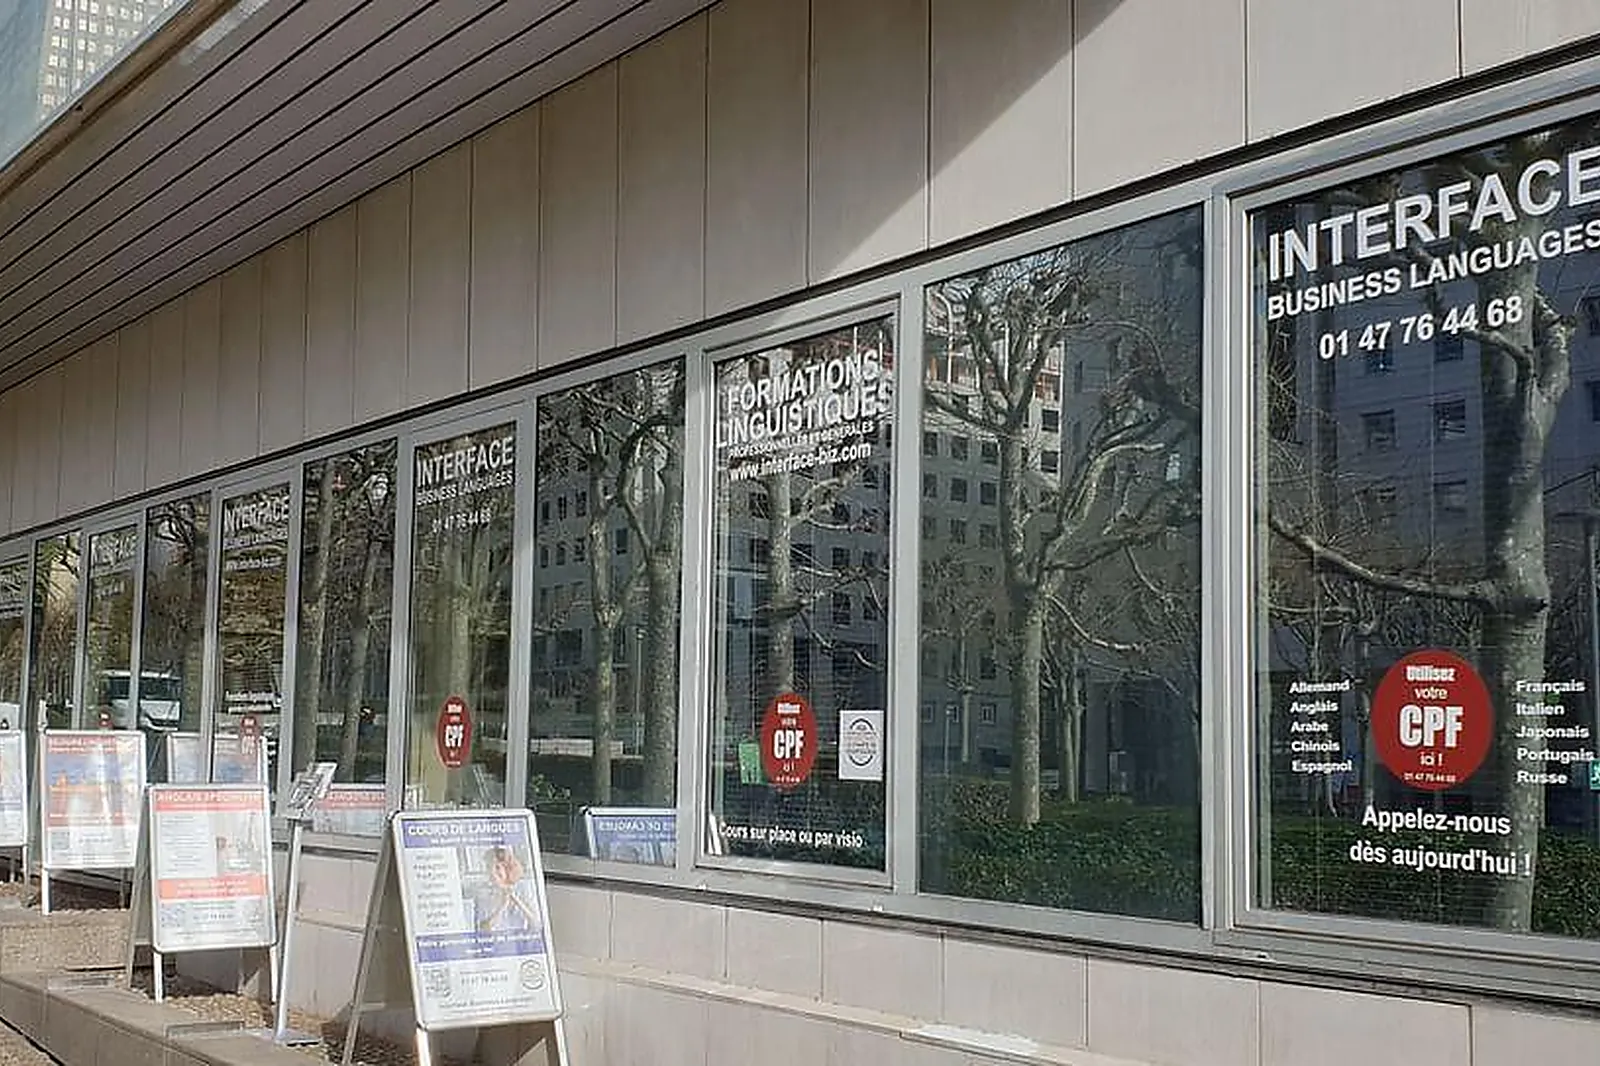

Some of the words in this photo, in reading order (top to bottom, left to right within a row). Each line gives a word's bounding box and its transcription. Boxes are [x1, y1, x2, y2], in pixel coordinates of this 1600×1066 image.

[1269, 144, 1600, 282] INTERFACE
[1267, 266, 1401, 320] BUSINESS
[1409, 218, 1600, 289] LANGUAGES
[1319, 329, 1348, 359] 01
[1358, 320, 1391, 351] 47
[1400, 312, 1435, 344] 76
[1442, 303, 1479, 335] 44
[1486, 295, 1523, 328] 68
[728, 349, 879, 414] FORMATIONS
[716, 381, 892, 449] LINGUISTIQUES
[416, 436, 514, 488] INTERFACE
[729, 443, 872, 481] www.interface-biz.com
[1289, 679, 1351, 695] Allemand
[1414, 686, 1449, 700] votre
[1516, 679, 1586, 694] Français
[1290, 699, 1339, 716] Anglais
[1516, 702, 1565, 717] Italien
[445, 724, 464, 748] CPF
[1290, 719, 1329, 733] Arabe
[1399, 703, 1464, 749] CPF
[1516, 725, 1590, 740] Japonais
[773, 729, 804, 760] CPF
[1291, 738, 1340, 753] Chinois
[1516, 747, 1594, 765] Portugais
[1291, 758, 1353, 775] Espagnol
[1419, 751, 1435, 766] ici
[1516, 770, 1568, 785] Russe
[1362, 805, 1512, 836] Appelez-nous
[719, 822, 748, 839] Cours
[750, 827, 766, 840] sur
[769, 825, 796, 845] place
[798, 830, 813, 844] ou
[814, 832, 834, 849] par
[835, 829, 863, 848] visio
[1350, 841, 1387, 865] dès
[1391, 846, 1517, 876] aujourd'hui
